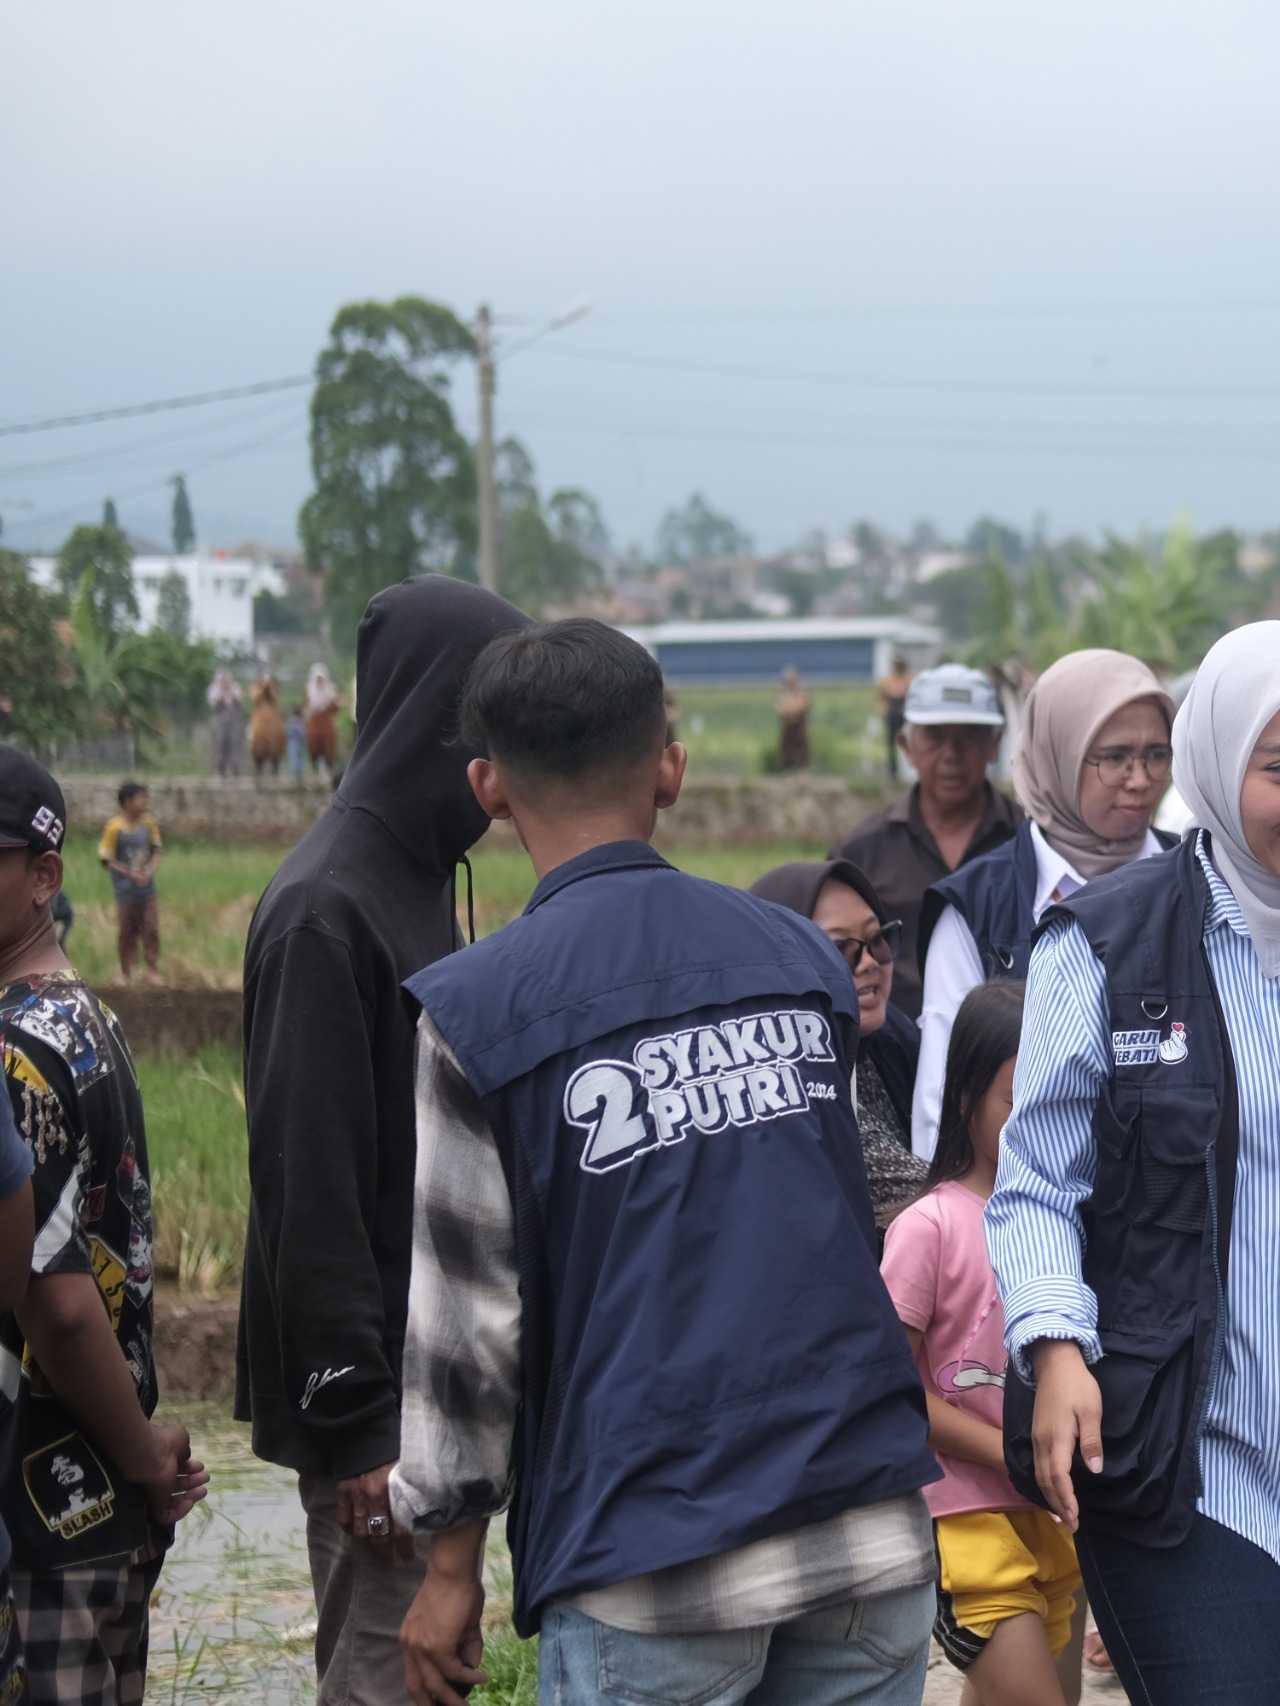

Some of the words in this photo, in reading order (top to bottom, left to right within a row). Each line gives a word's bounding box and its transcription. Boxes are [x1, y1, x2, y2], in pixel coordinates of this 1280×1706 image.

[32, 806, 63, 845] 93
[1114, 1031, 1159, 1046] GARUT
[1116, 1049, 1157, 1063] EBAT!
[565, 1060, 652, 1173] 2
[634, 1011, 830, 1088] SYAKUR
[650, 1063, 803, 1143] PUTRI
[807, 1081, 837, 1100] 2024
[61, 1502, 111, 1537] SLASH
